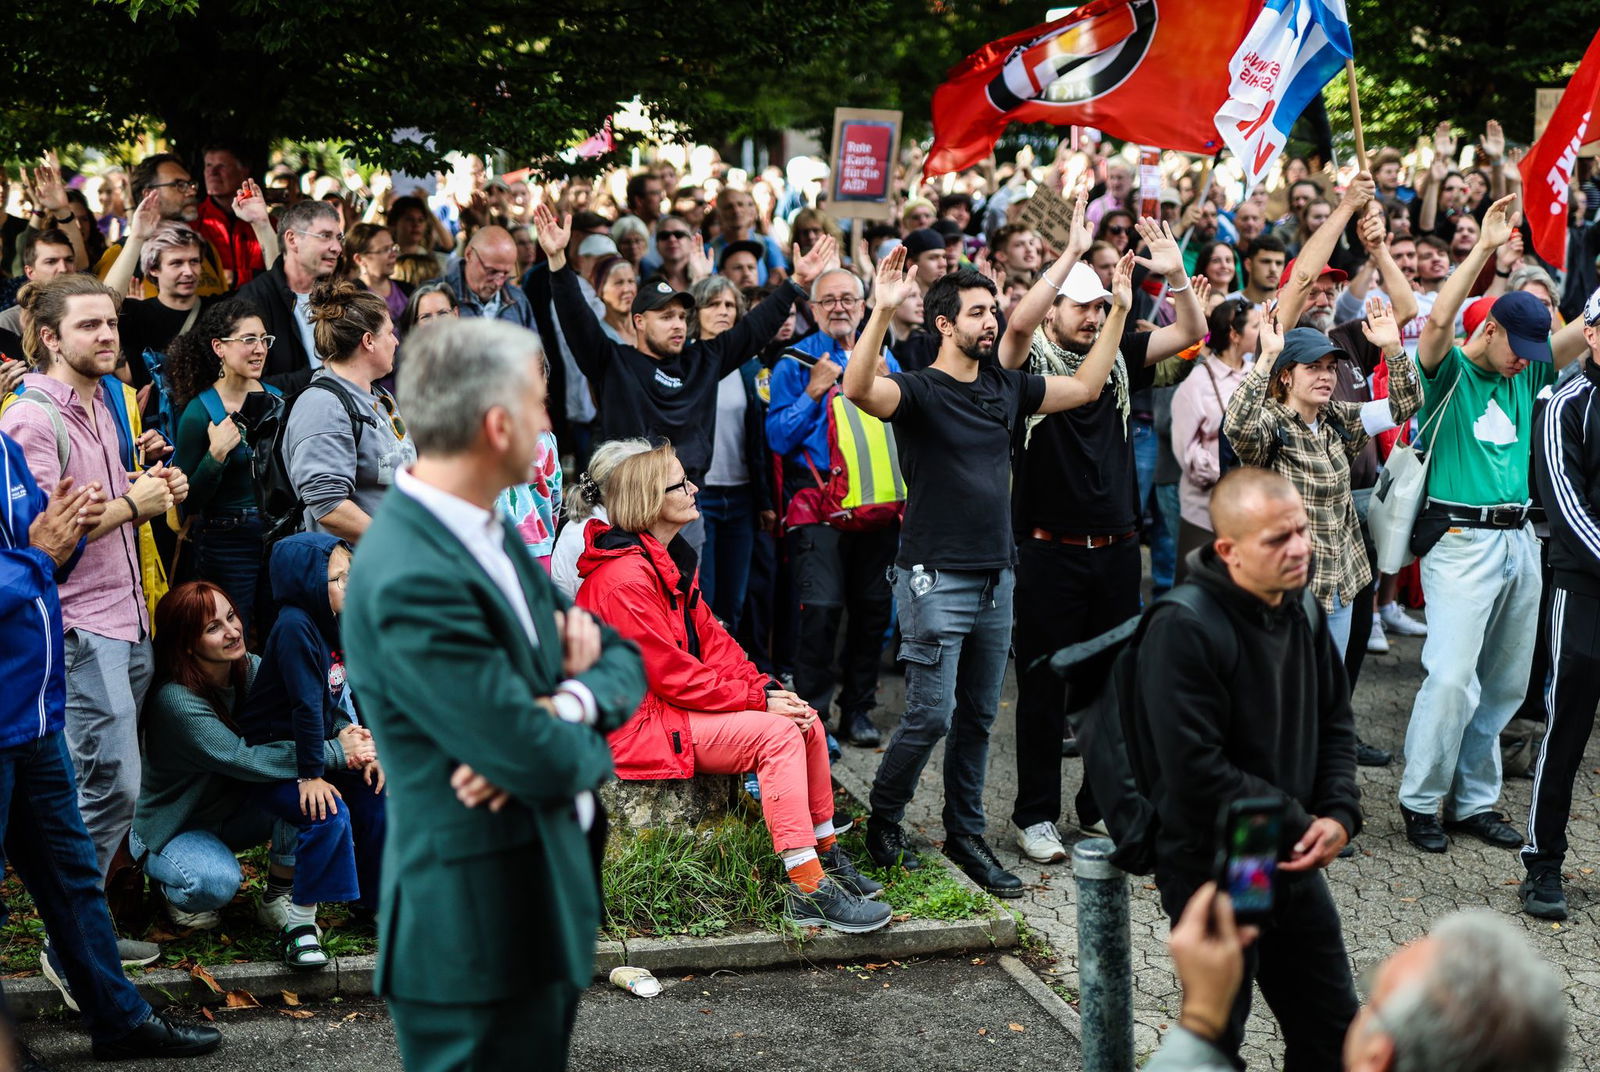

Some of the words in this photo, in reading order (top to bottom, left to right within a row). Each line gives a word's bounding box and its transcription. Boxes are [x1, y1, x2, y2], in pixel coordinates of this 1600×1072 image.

[846, 141, 872, 154] Rote
[846, 154, 877, 166] Karte
[844, 165, 863, 178] für
[862, 167, 880, 179] die
[843, 179, 868, 192] AfD!
